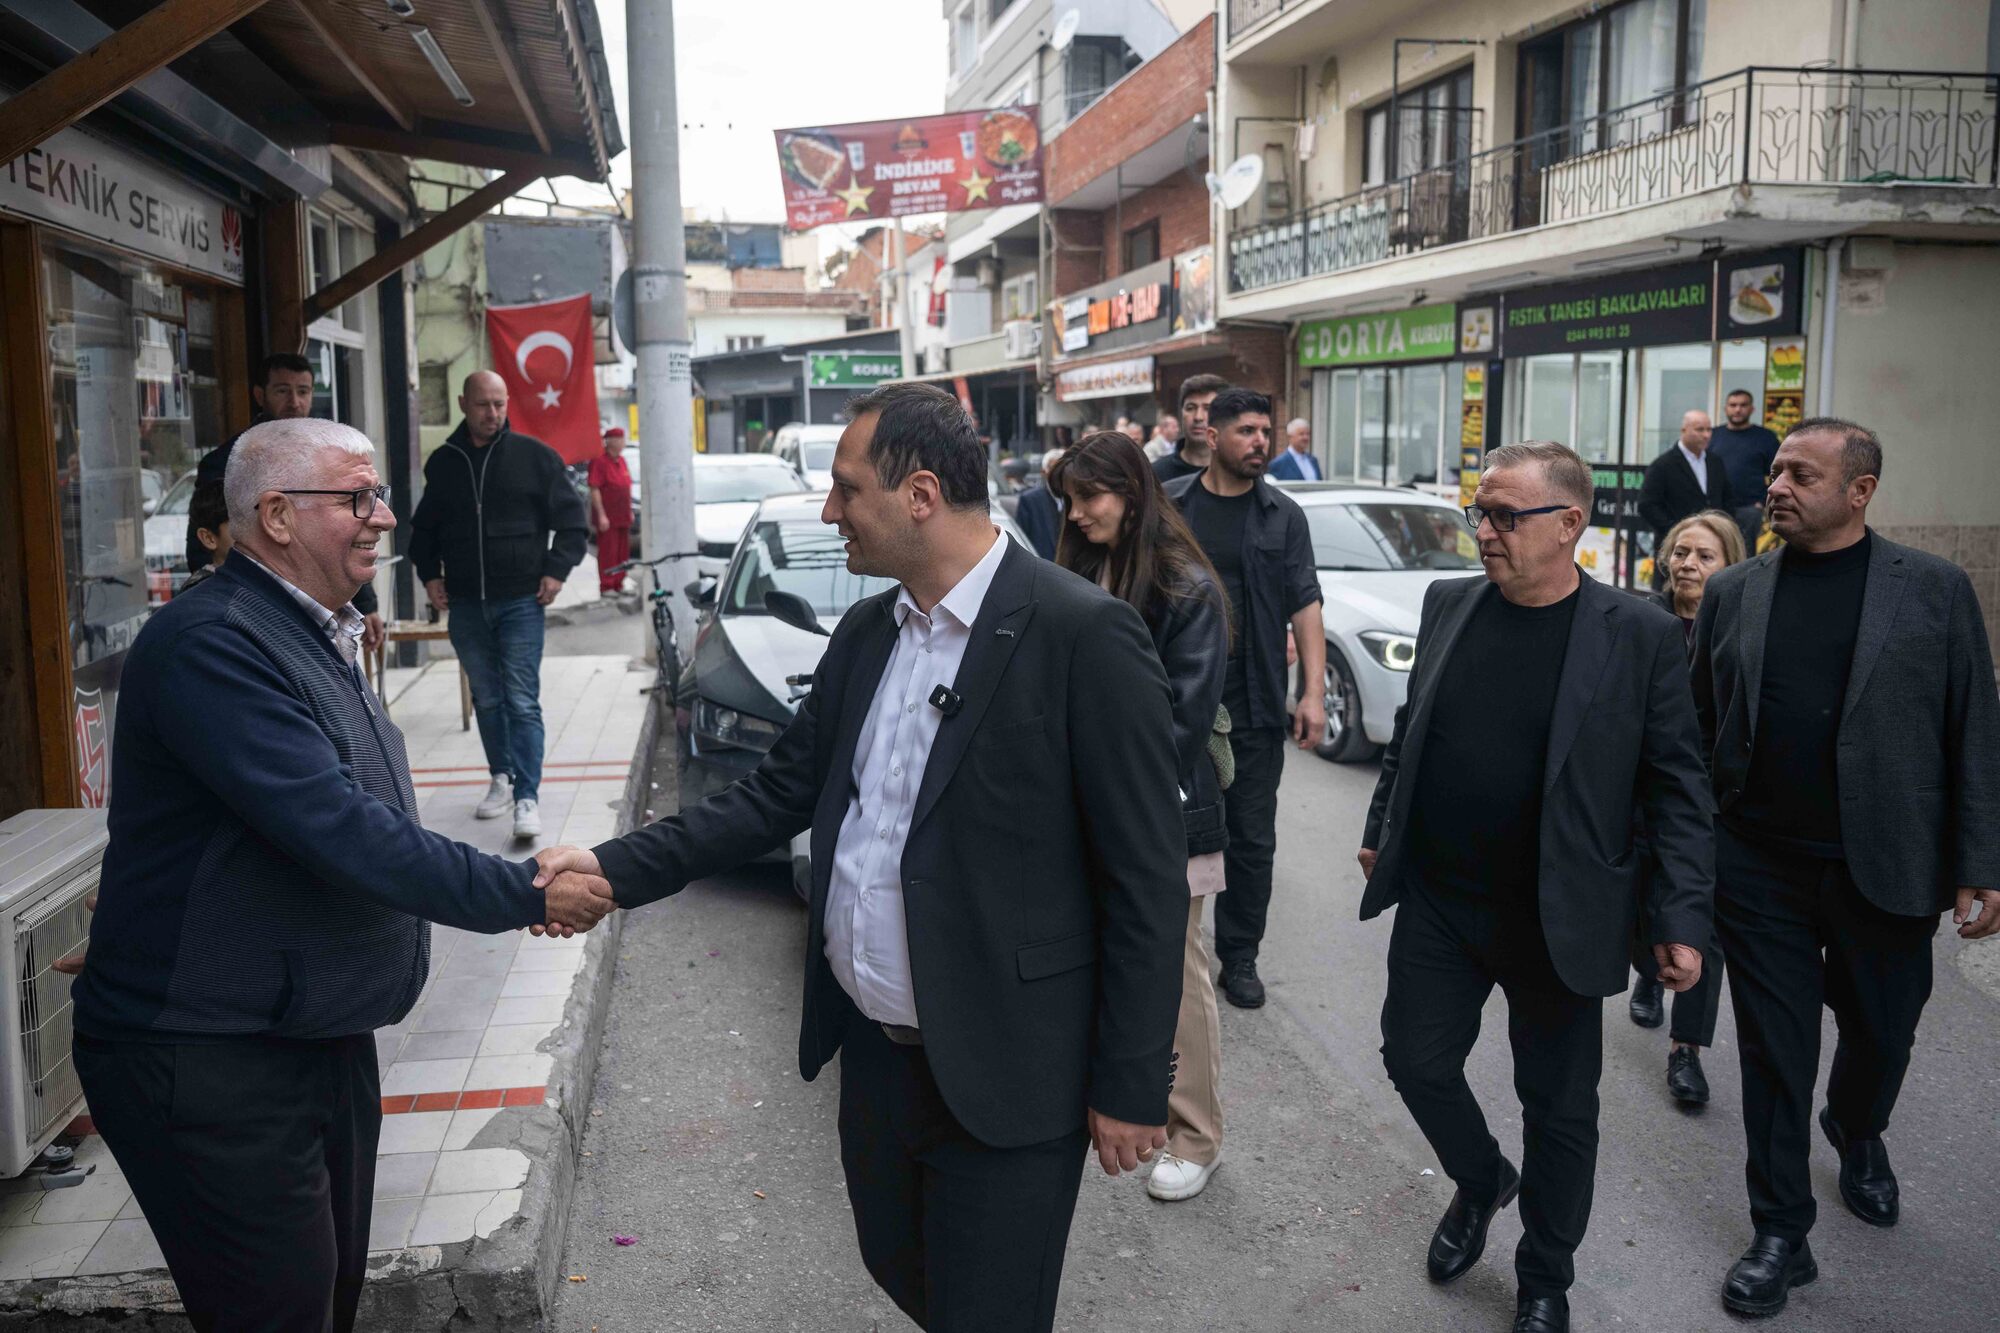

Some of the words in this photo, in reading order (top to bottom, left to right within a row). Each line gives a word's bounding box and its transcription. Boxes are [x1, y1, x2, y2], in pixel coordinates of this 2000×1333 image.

[874, 158, 956, 181] İNDİRİME
[893, 179, 941, 196] DEVAM
[7, 148, 120, 222] TEKNİK
[129, 189, 210, 252] SERVİS
[1509, 307, 1546, 327] FISTIK
[1550, 293, 1596, 323] TANESİ
[1600, 284, 1706, 317] BAKLAVALARI
[1318, 318, 1406, 359] DORYA
